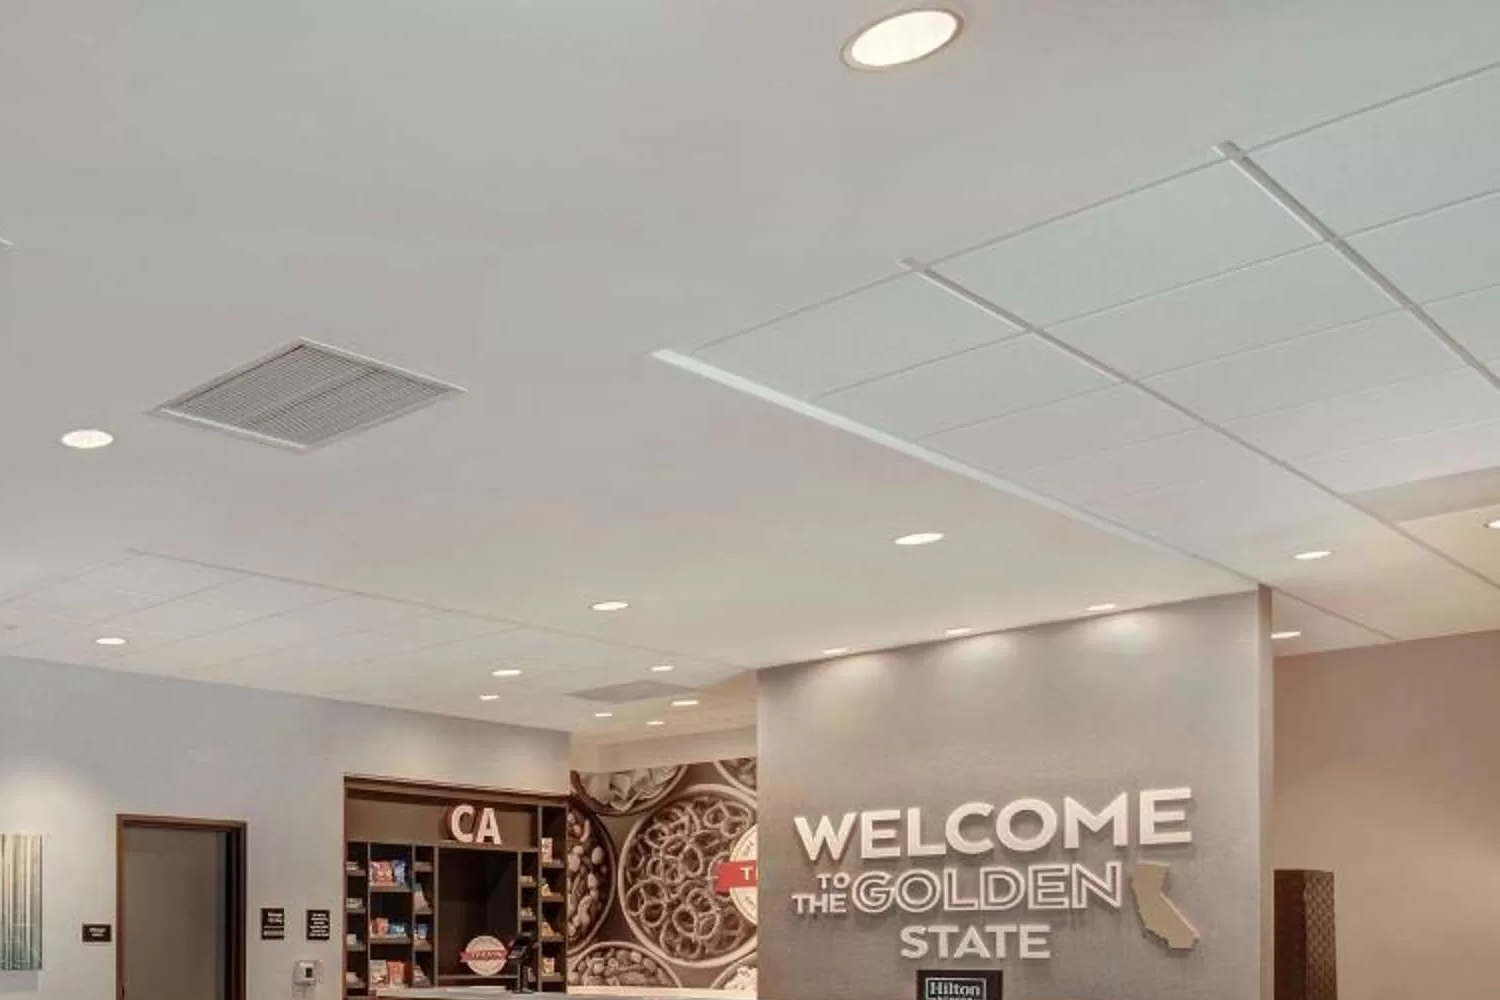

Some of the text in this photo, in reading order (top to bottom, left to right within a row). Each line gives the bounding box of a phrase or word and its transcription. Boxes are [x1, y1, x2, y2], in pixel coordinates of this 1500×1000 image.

[451, 804, 502, 845] CA
[793, 787, 1192, 861] WELCOME
[792, 861, 1122, 914] THE GOLDEN
[816, 872, 851, 889] TO
[900, 924, 1050, 959] STATE
[929, 981, 981, 996] Hilton
